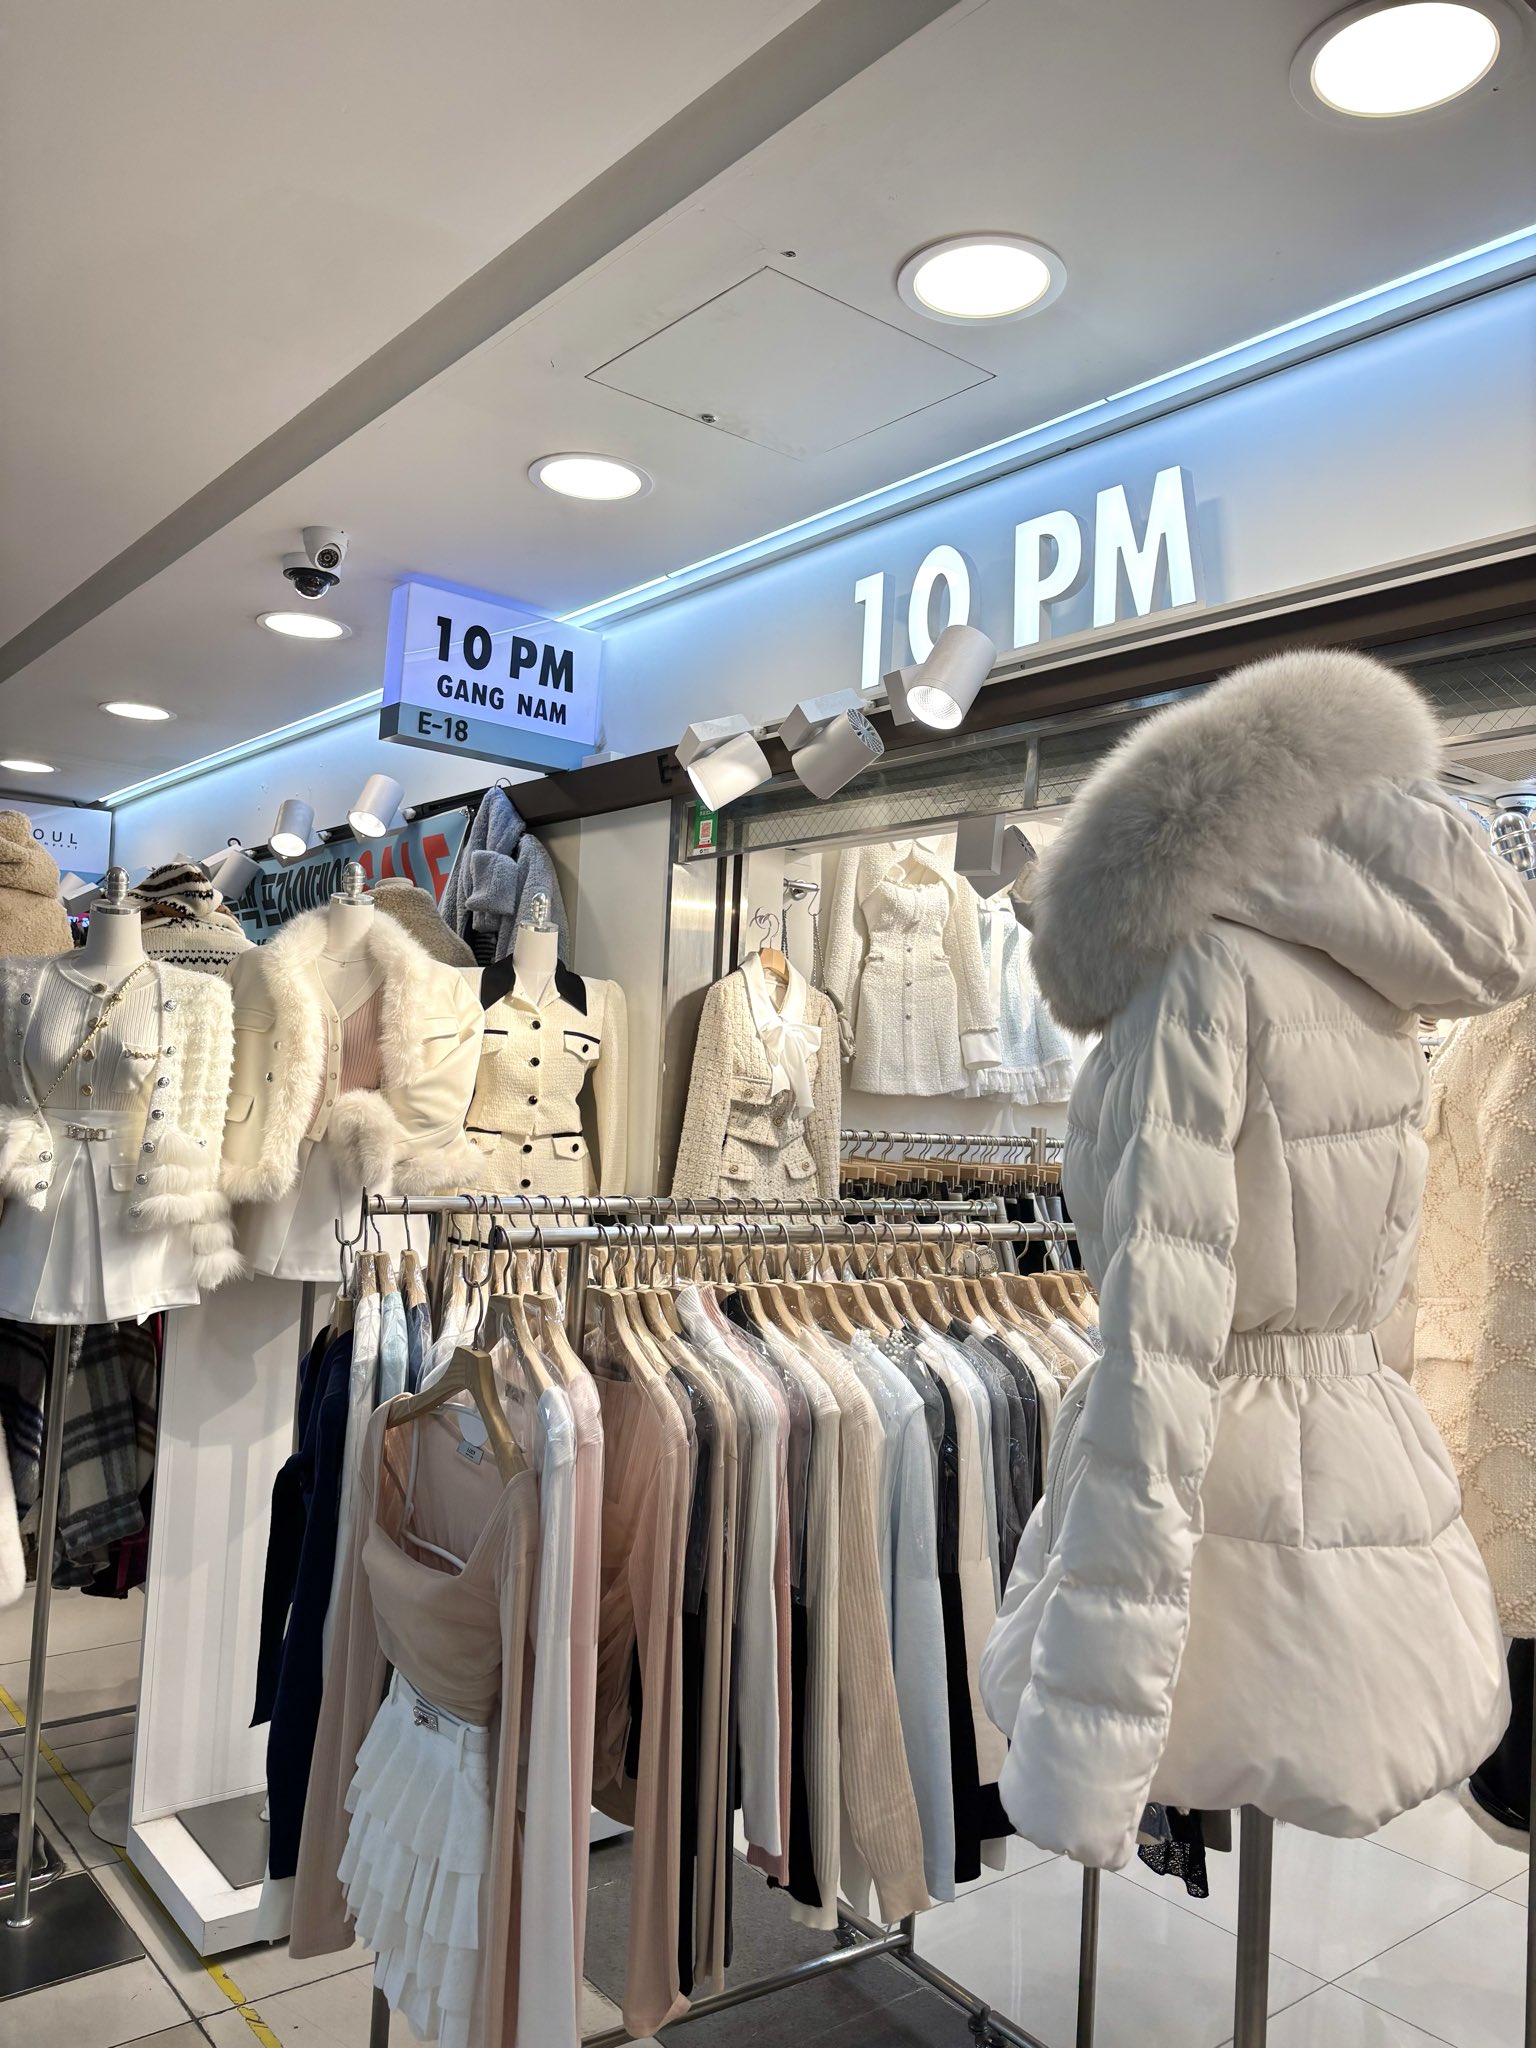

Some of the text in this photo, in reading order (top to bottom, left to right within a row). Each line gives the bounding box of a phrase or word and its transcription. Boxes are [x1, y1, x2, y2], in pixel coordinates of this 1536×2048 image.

[854, 465, 1198, 689] 10 PM
[437, 616, 574, 693] 10 PM
[437, 674, 567, 725] GANG NAM
[418, 711, 469, 742] E-18
[33, 828, 78, 844] OUL
